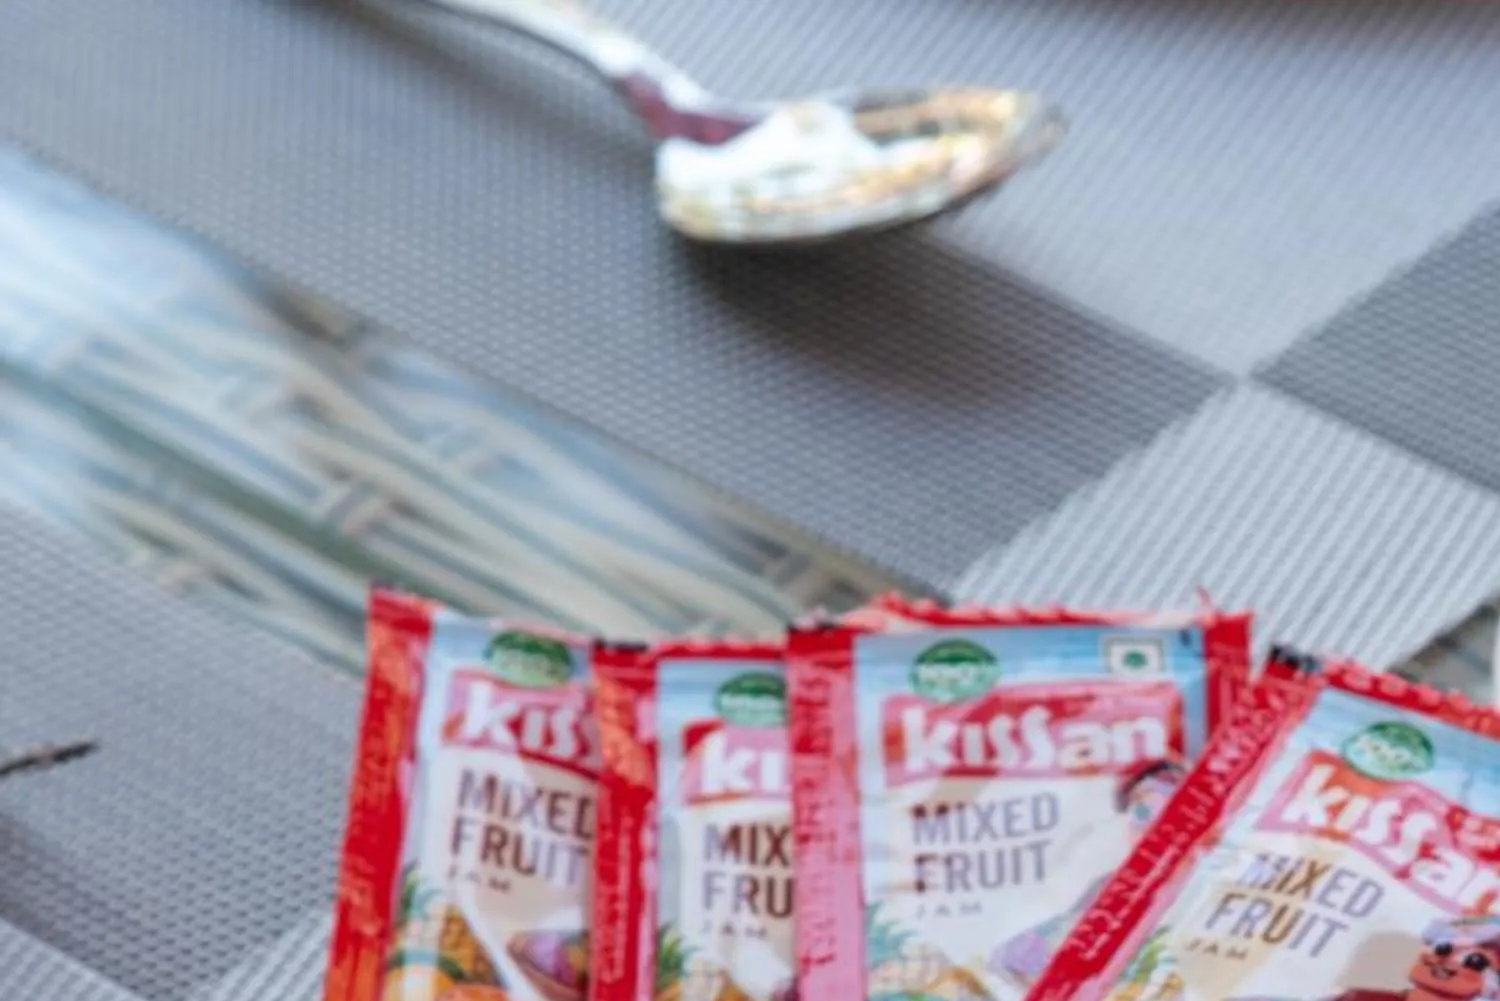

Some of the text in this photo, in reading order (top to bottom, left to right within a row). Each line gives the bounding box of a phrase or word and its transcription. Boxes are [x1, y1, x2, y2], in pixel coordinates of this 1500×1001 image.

[703, 821, 791, 869] MIX
[911, 792, 1060, 846] MIXED
[914, 839, 1053, 893] FRUIT
[1237, 851, 1386, 920] MIXED
[703, 869, 795, 919] FRU
[1204, 892, 1349, 959] FRUIT
